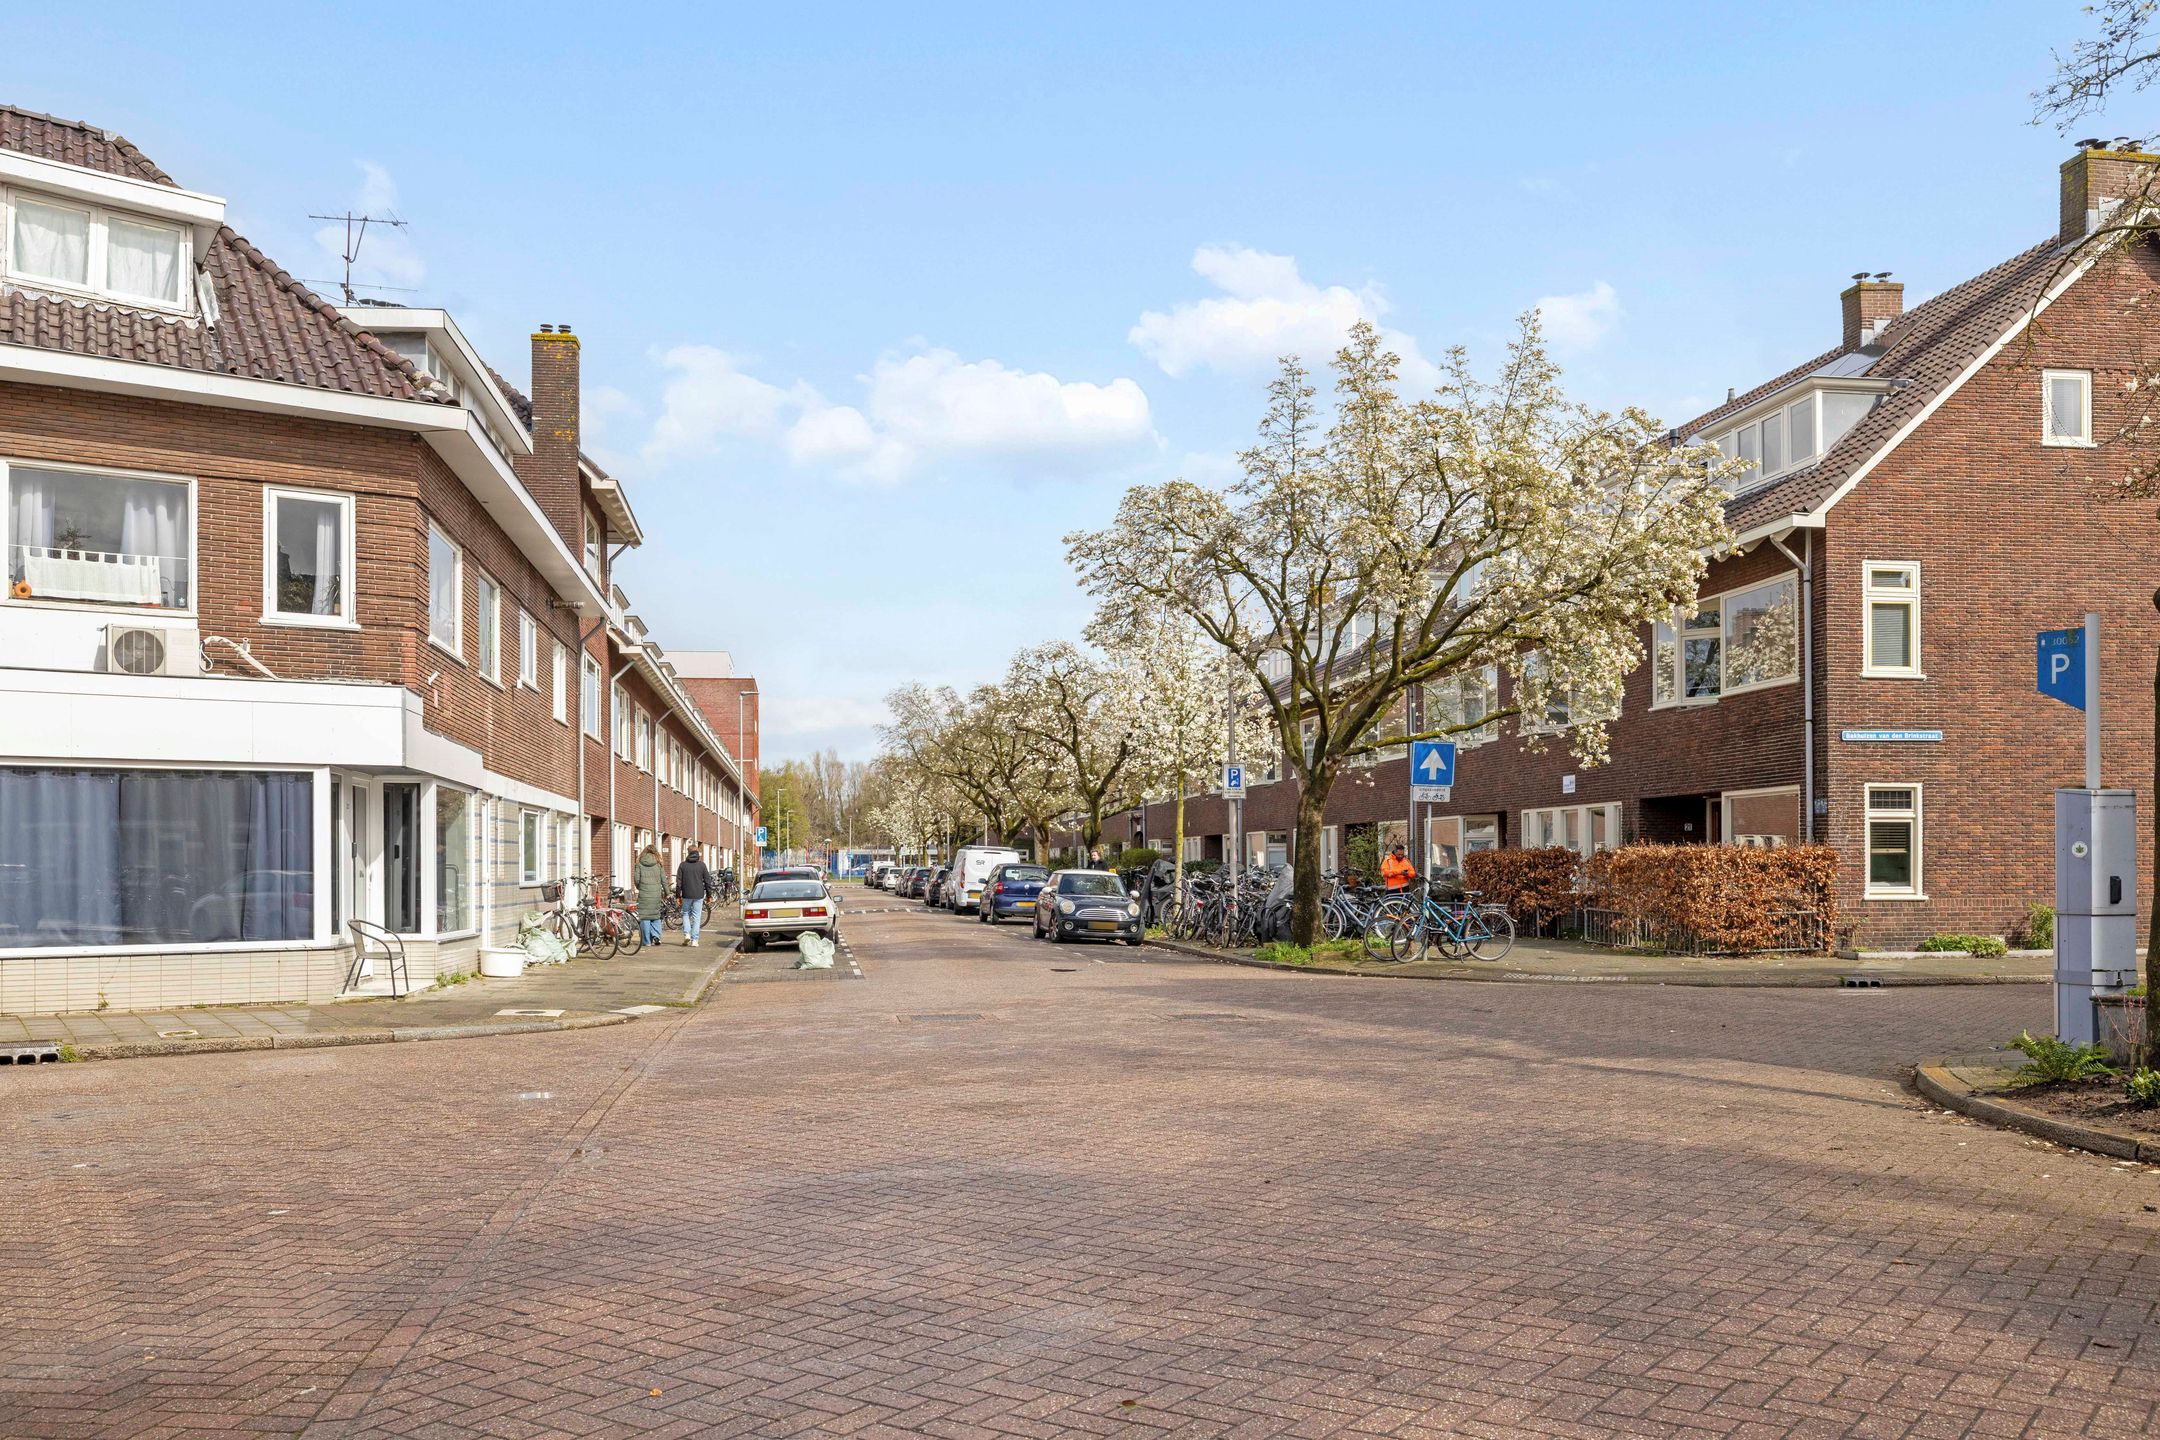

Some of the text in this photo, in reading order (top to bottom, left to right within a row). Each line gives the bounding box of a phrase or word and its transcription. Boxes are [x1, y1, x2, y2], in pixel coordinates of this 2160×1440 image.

[2051, 653, 2070, 685] P
[1845, 732, 1877, 740] Bakhuizen
[1891, 732, 1903, 740] den
[1904, 732, 1939, 740] Brinkstraat
[1231, 769, 1239, 779] P
[758, 828, 765, 837] P
